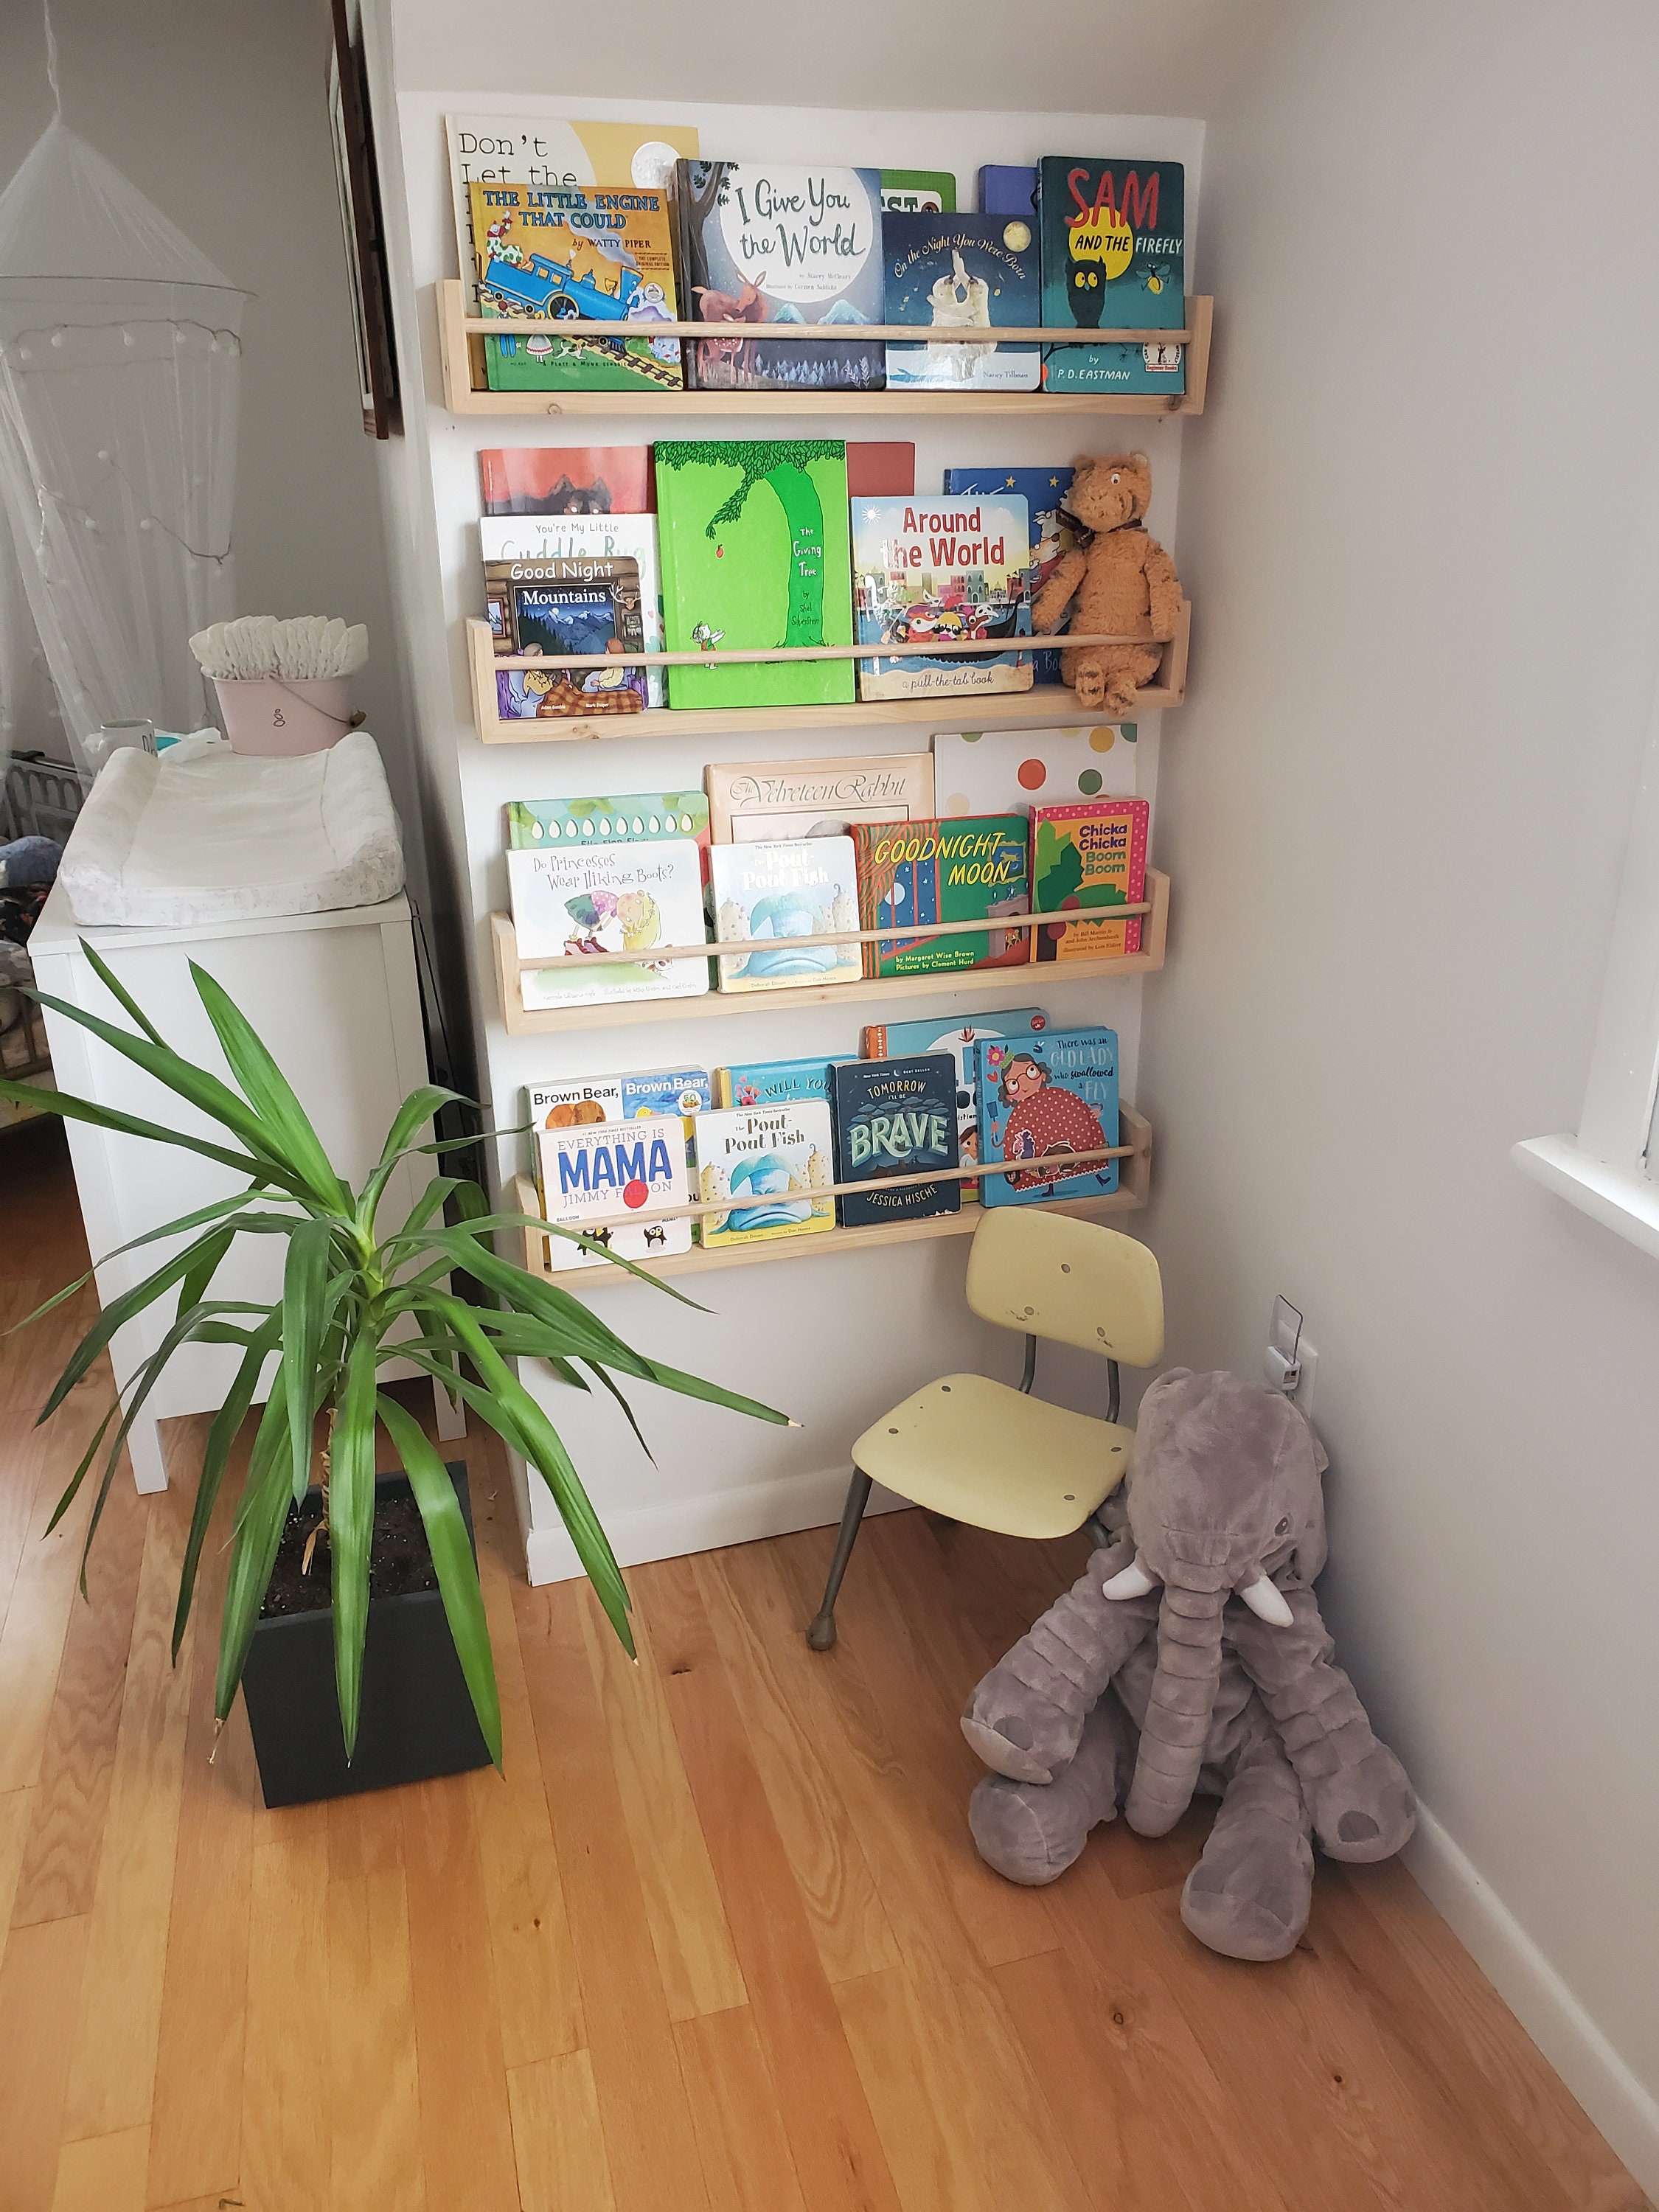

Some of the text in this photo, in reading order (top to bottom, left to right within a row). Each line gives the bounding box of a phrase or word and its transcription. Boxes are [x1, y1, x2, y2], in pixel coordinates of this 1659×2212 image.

[459, 133, 549, 157] Don't
[461, 164, 577, 186] Let the
[483, 190, 660, 212] THE LITTLE ENGINE
[734, 177, 851, 226] I Give You
[1064, 167, 1160, 229] SAM
[518, 211, 627, 229] THAT COULD
[571, 238, 652, 251] by WATTY PIPER
[740, 222, 866, 267] the World
[1074, 234, 1183, 254] AND THE FIREFLY
[894, 233, 1026, 280] On the Night You Were Born
[1088, 354, 1099, 365] by
[983, 370, 1029, 380] Nancy Tillman
[535, 523, 619, 535] You're My Little
[902, 506, 981, 533] Around
[799, 526, 814, 536] The
[793, 540, 822, 558] Giving
[880, 536, 1005, 568] the World
[510, 560, 614, 582] Good Night
[799, 561, 817, 577] Tree
[522, 588, 607, 605] Mountains
[802, 590, 810, 599] by
[799, 602, 813, 613] Shel
[902, 671, 995, 693] a pull-the-tab book
[729, 776, 835, 807] Velveteen
[835, 773, 906, 803] Rabbit
[1079, 823, 1127, 838] Chicka
[874, 831, 1006, 864] GOODNIGHT
[1079, 836, 1127, 851] Chicka
[533, 853, 616, 872] Do Princesses
[1086, 851, 1127, 863] Boom
[546, 864, 675, 891] Wear Hiking Boots?
[740, 866, 830, 891] Pout Fish
[947, 860, 1012, 886] MOON
[1085, 863, 1126, 876] Boom
[895, 956, 903, 964] by
[905, 953, 934, 962] Margaret
[1057, 1040, 1079, 1049] There
[1080, 1038, 1096, 1046] was
[1050, 1046, 1115, 1068] OLD LADY
[1054, 1066, 1114, 1079] who swallowed
[534, 1087, 619, 1106] Brown Bear,
[625, 1077, 709, 1096] Brown Bear,
[765, 1078, 801, 1099] WILL
[806, 1077, 832, 1093] YOU
[866, 1079, 927, 1099] TOMORROW
[1085, 1079, 1107, 1100] FLY
[746, 1114, 793, 1135] Pout-
[557, 1128, 665, 1151] EVERYTHING IS
[724, 1129, 805, 1155] Pout Fish
[849, 1112, 949, 1168] BRAVE
[557, 1138, 673, 1194] MAMA
[563, 1189, 610, 1208] JIMMY
[866, 1183, 938, 1207] JESSICA HISCHE
